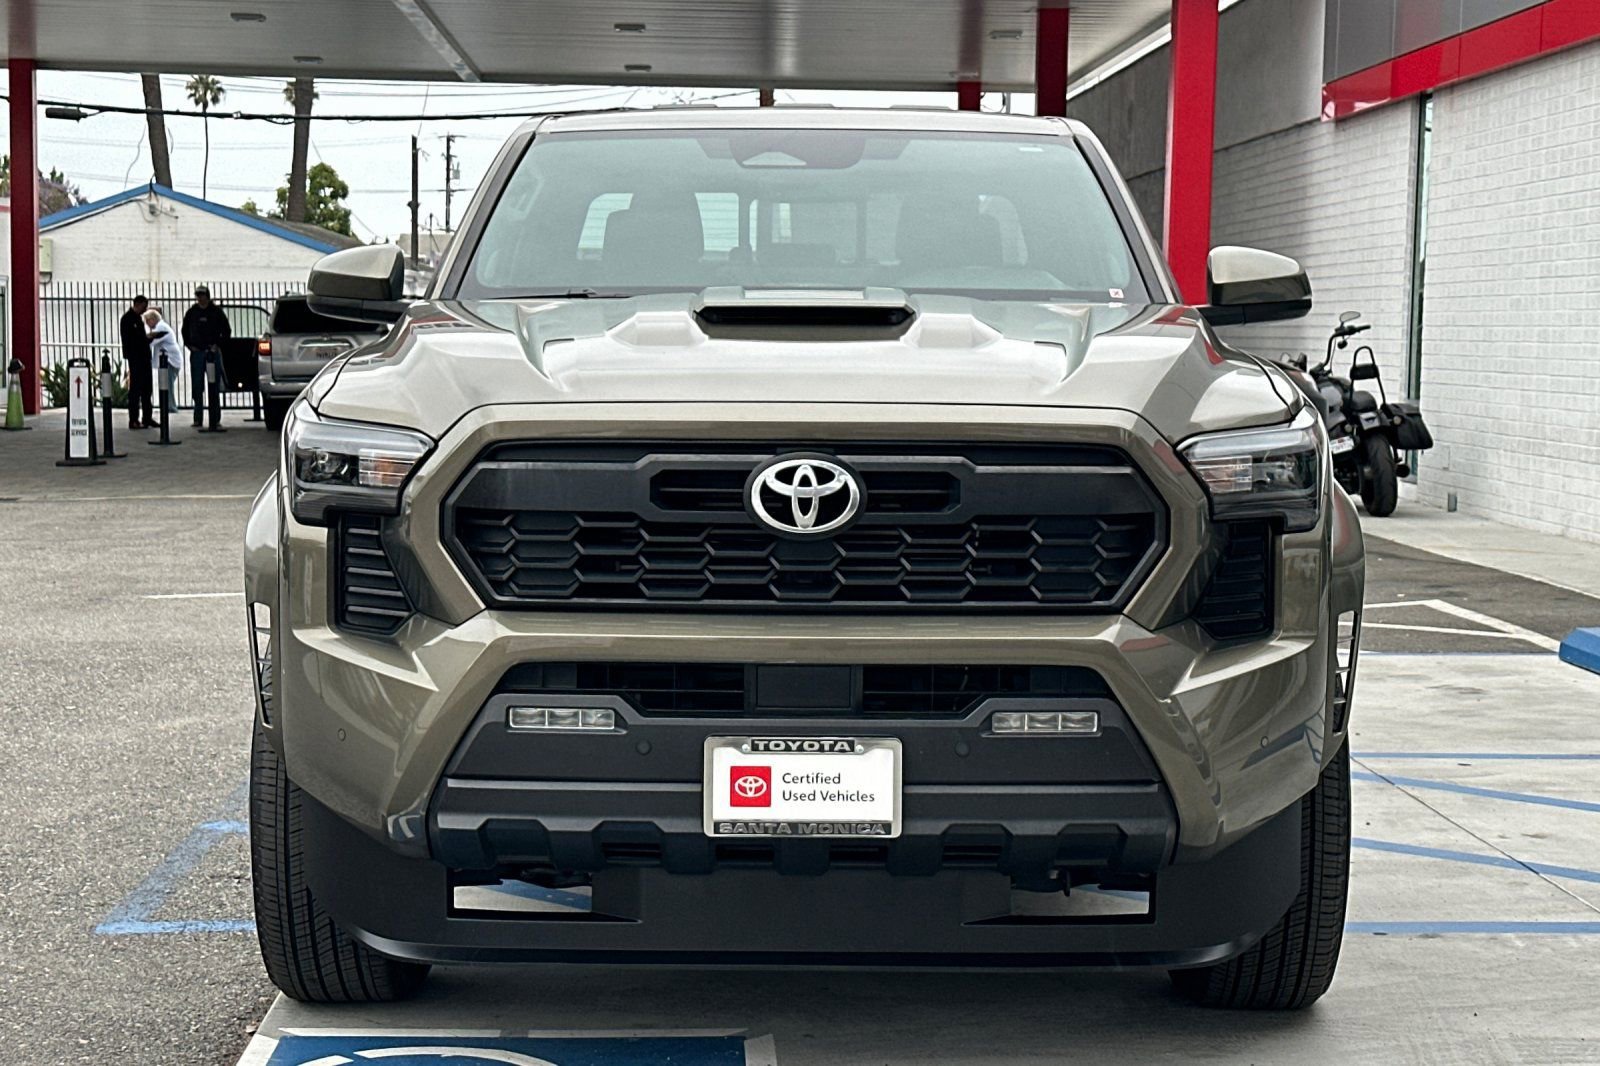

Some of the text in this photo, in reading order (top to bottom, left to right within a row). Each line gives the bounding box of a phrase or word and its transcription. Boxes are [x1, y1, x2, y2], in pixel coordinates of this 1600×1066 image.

[754, 740, 851, 752] TOYOTA
[782, 772, 841, 784] Certified
[782, 790, 875, 802] Used Vehicles
[719, 822, 886, 835] SANTA MONICA
